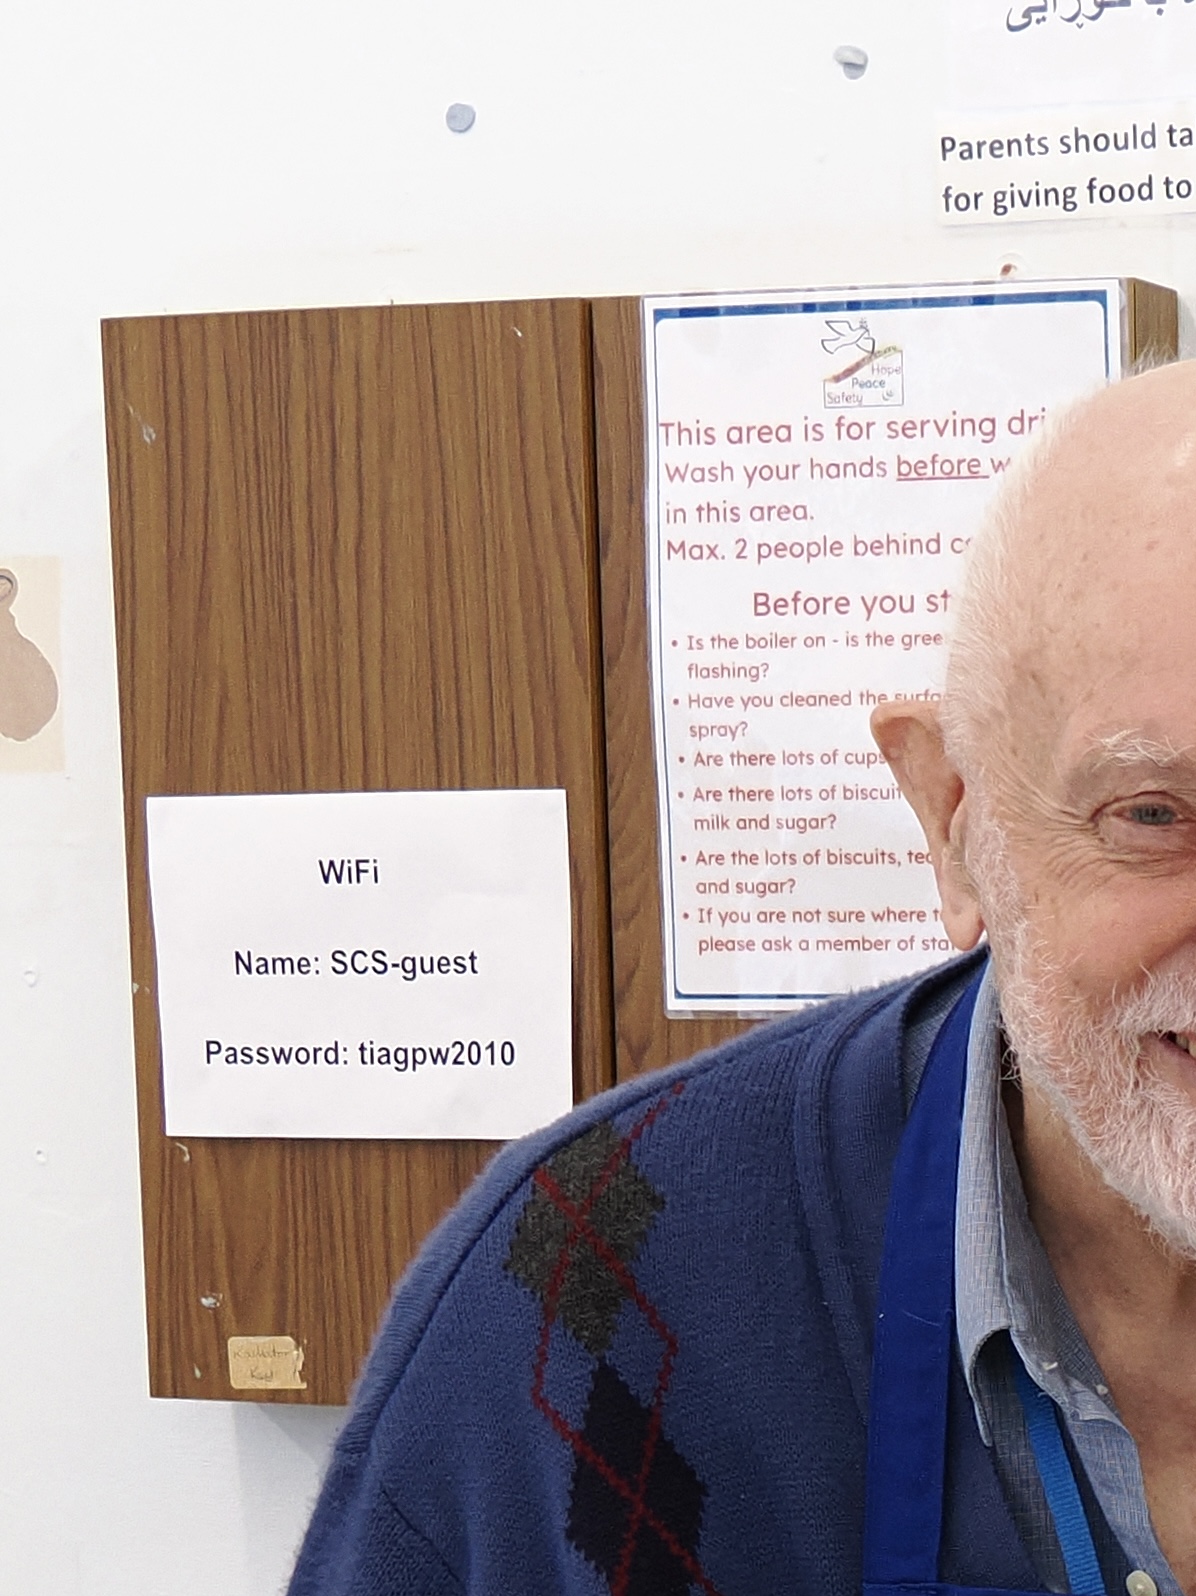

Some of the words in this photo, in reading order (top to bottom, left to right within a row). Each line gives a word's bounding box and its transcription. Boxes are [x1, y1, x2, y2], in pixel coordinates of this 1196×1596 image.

[941, 133, 1049, 161] Parents
[1060, 122, 1156, 154] should
[943, 186, 983, 212] for
[994, 181, 1077, 216] giving
[1087, 174, 1153, 204] food
[1163, 176, 1191, 199] to
[872, 364, 902, 376] Hope
[851, 377, 886, 389] Peace
[827, 391, 863, 405] Safety
[659, 420, 717, 447] This
[727, 424, 791, 445] area
[804, 416, 824, 442] is
[835, 415, 875, 441] for
[887, 410, 996, 444] serving
[665, 460, 734, 484] Wash
[743, 463, 801, 488] your
[810, 456, 887, 479] hands
[896, 454, 984, 481] before
[667, 502, 686, 524] in
[696, 500, 740, 524] this
[750, 504, 813, 522] area.
[667, 540, 725, 561] Max.
[736, 538, 747, 559] 2
[758, 534, 843, 565] people
[854, 532, 940, 557] behind
[754, 590, 850, 617] Before
[861, 594, 914, 622] you
[688, 635, 703, 651] Is
[710, 634, 739, 650] the
[746, 632, 797, 649] boiler
[804, 636, 825, 648] on
[846, 630, 859, 647] is
[865, 630, 894, 647] the
[901, 633, 942, 651] gree
[688, 662, 769, 682] flashing?
[690, 721, 748, 742] spray?
[694, 814, 729, 831] milk
[736, 813, 769, 830] and
[777, 813, 836, 835] sugar?
[319, 858, 378, 885] WiFi
[699, 935, 755, 956] please
[762, 935, 792, 951] ask
[799, 939, 809, 951] a
[816, 935, 891, 951] member
[897, 935, 915, 951] of
[922, 936, 952, 951] sta
[235, 950, 319, 975] Name:
[332, 949, 478, 981] SCS-guest
[206, 1040, 347, 1065] Password:
[359, 1040, 514, 1072] tiagpw2010
